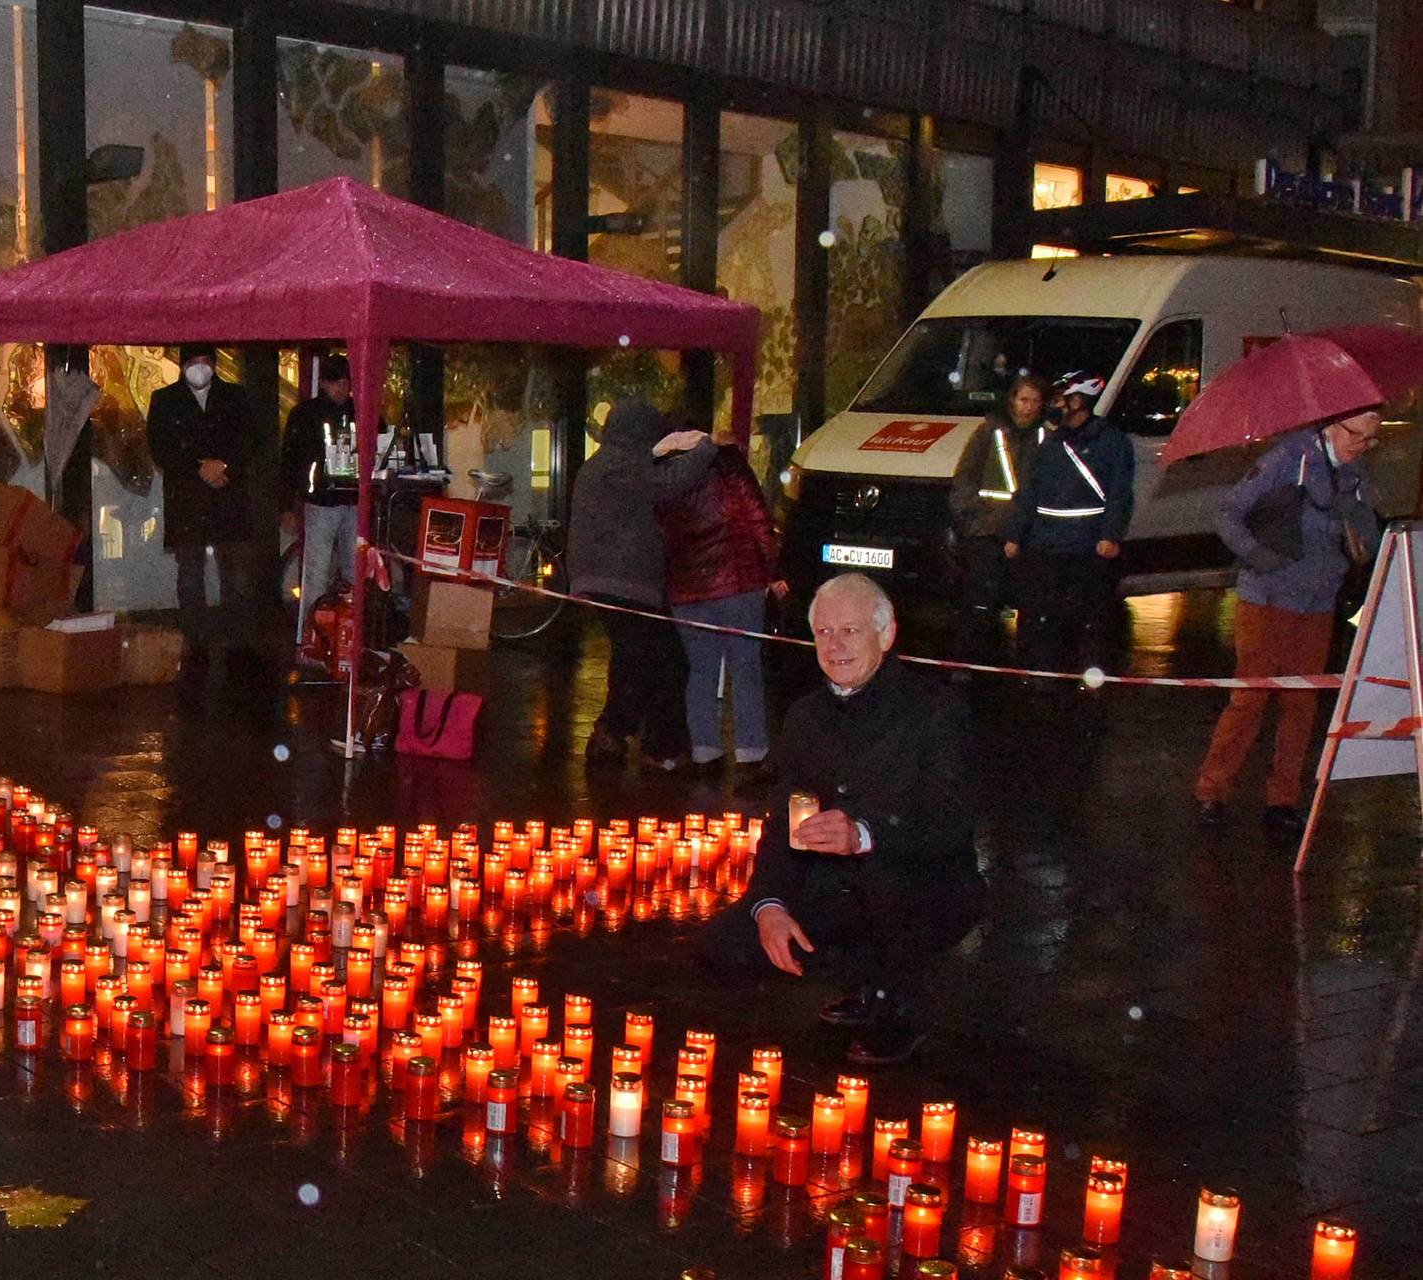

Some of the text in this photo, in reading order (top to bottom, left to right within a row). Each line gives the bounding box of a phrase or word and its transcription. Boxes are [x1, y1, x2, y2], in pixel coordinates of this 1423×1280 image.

[829, 548, 890, 565] AC CV 1600
